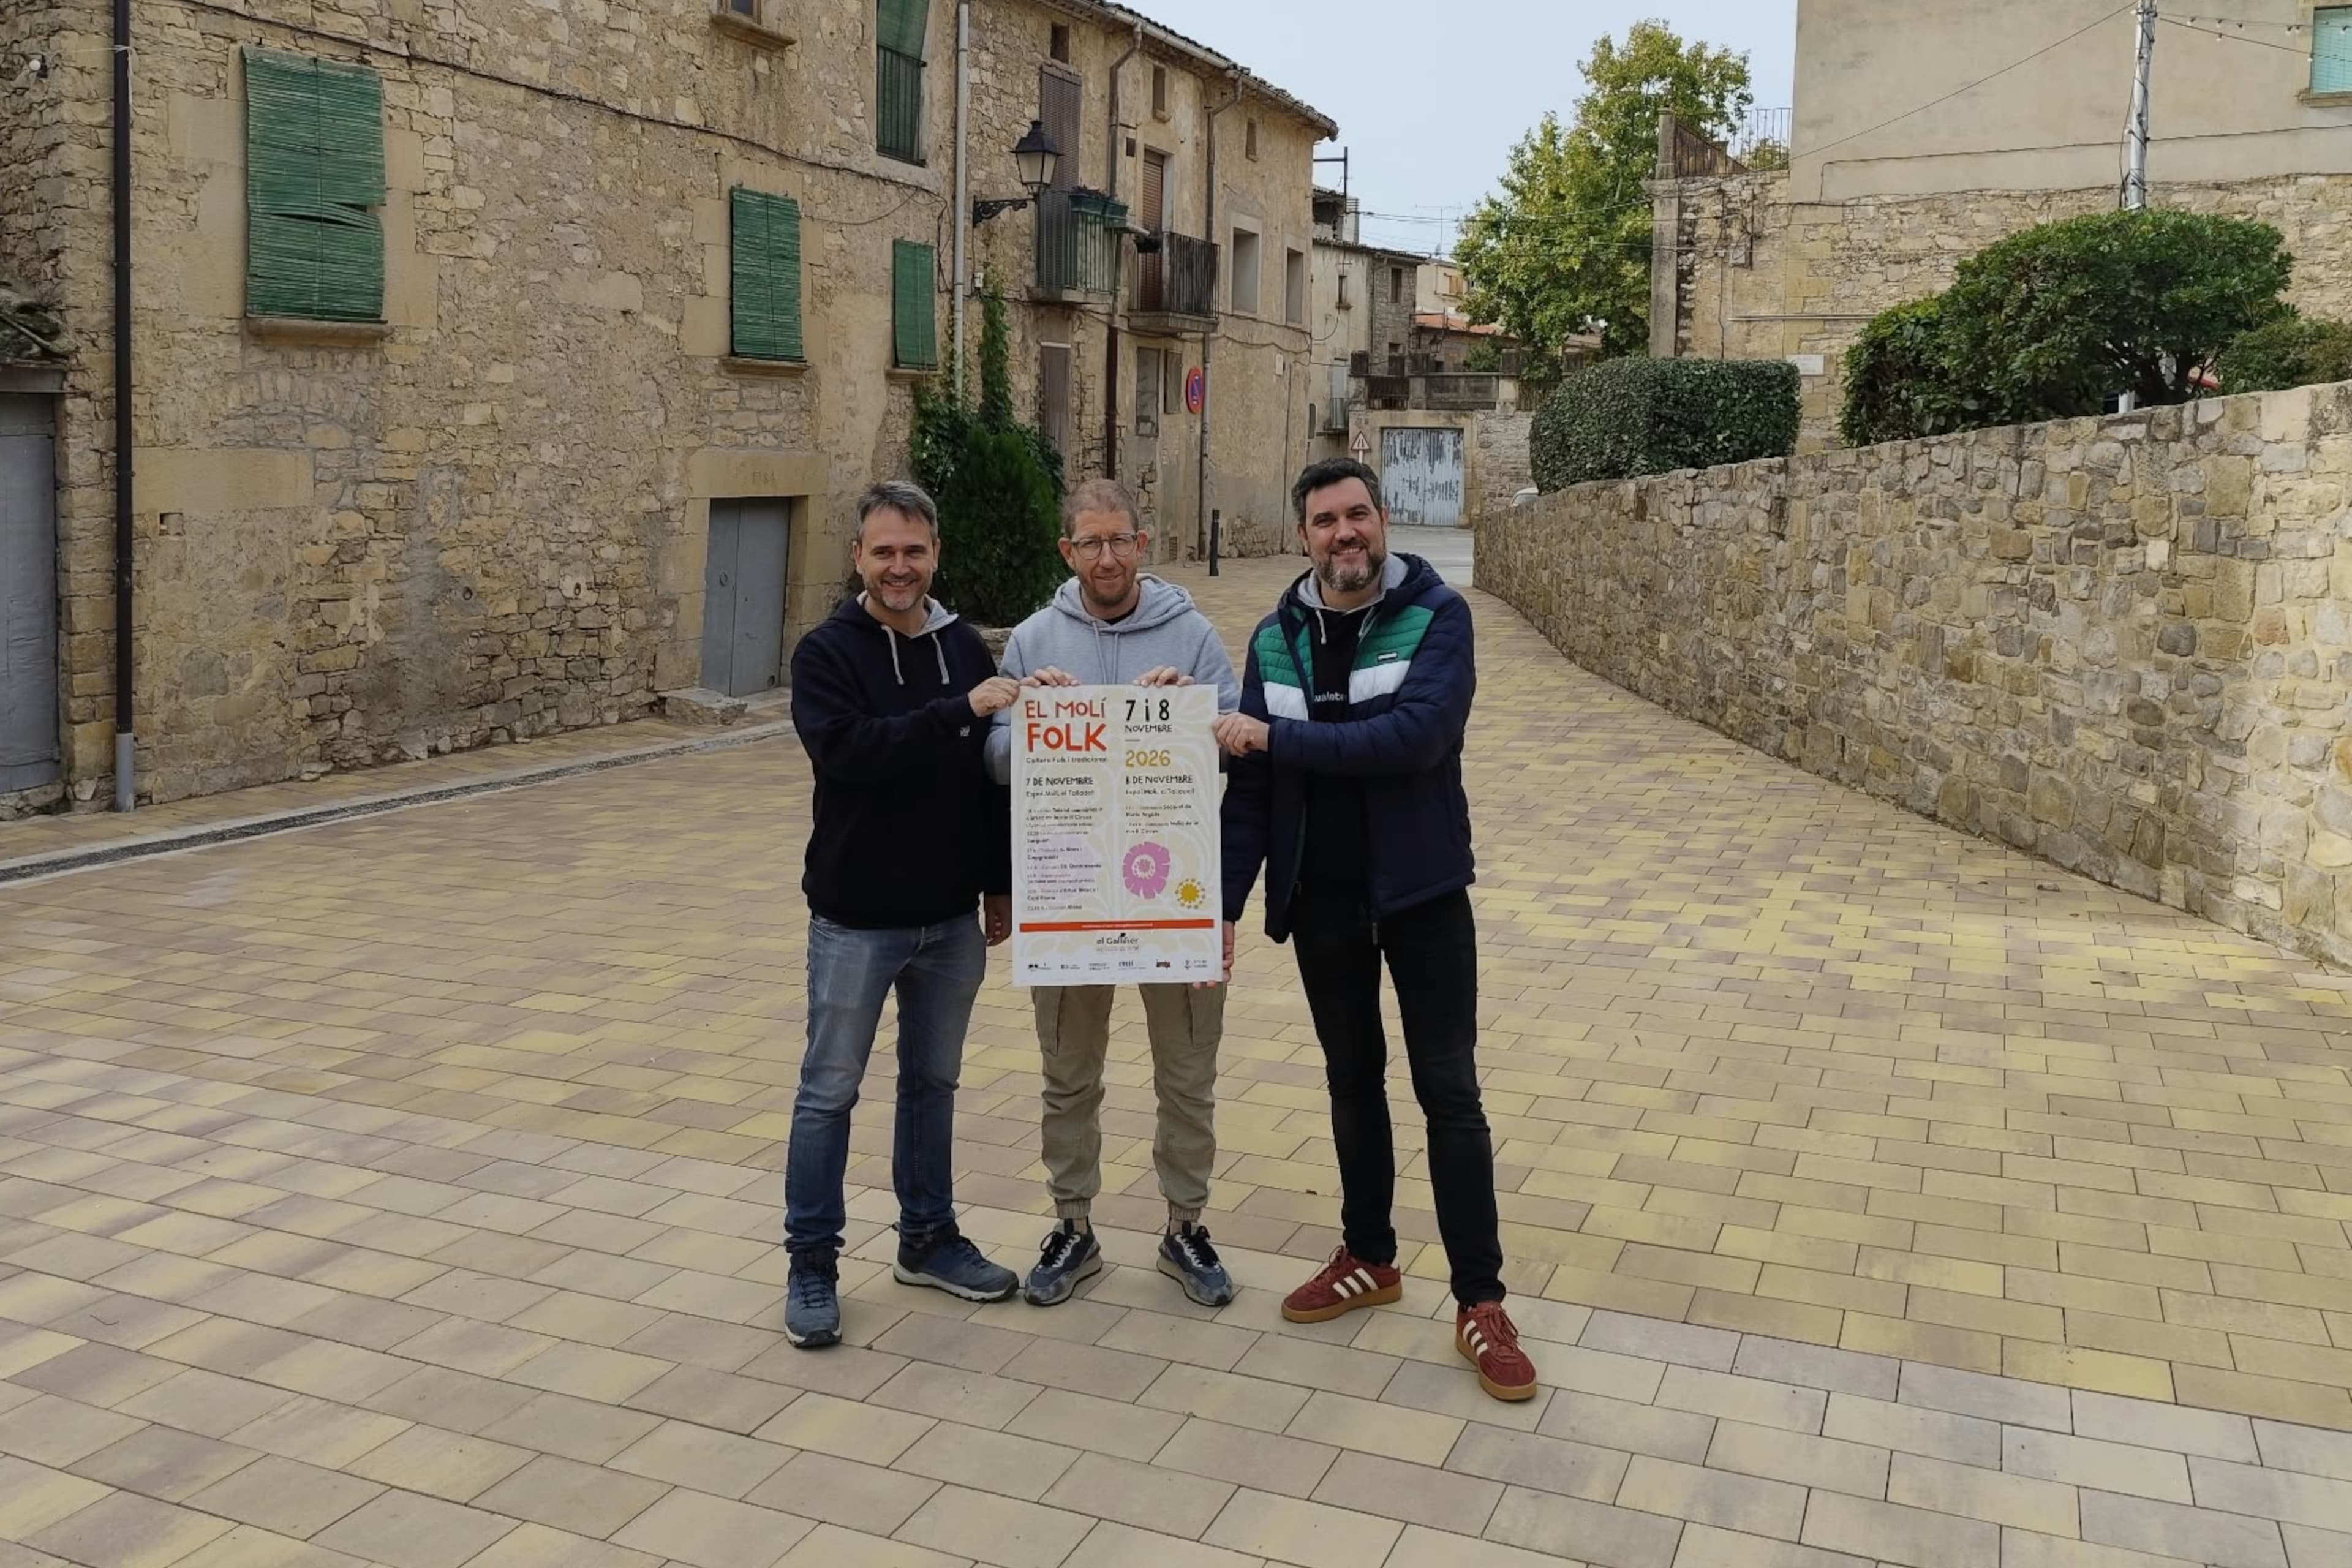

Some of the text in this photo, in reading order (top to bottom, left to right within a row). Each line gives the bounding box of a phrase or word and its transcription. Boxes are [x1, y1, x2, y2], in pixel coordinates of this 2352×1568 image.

[1025, 697, 1107, 718] EL MOLÍ
[1126, 699, 1169, 722] 7 i 8
[1027, 722, 1107, 752] FOLK
[1125, 724, 1172, 733] NOVEMBRE
[1126, 750, 1171, 767] 2026
[1033, 777, 1043, 786] DE
[1046, 776, 1093, 786] NOVEMBRE
[1133, 775, 1143, 784] DE
[1145, 774, 1193, 784] NOVEMBRE
